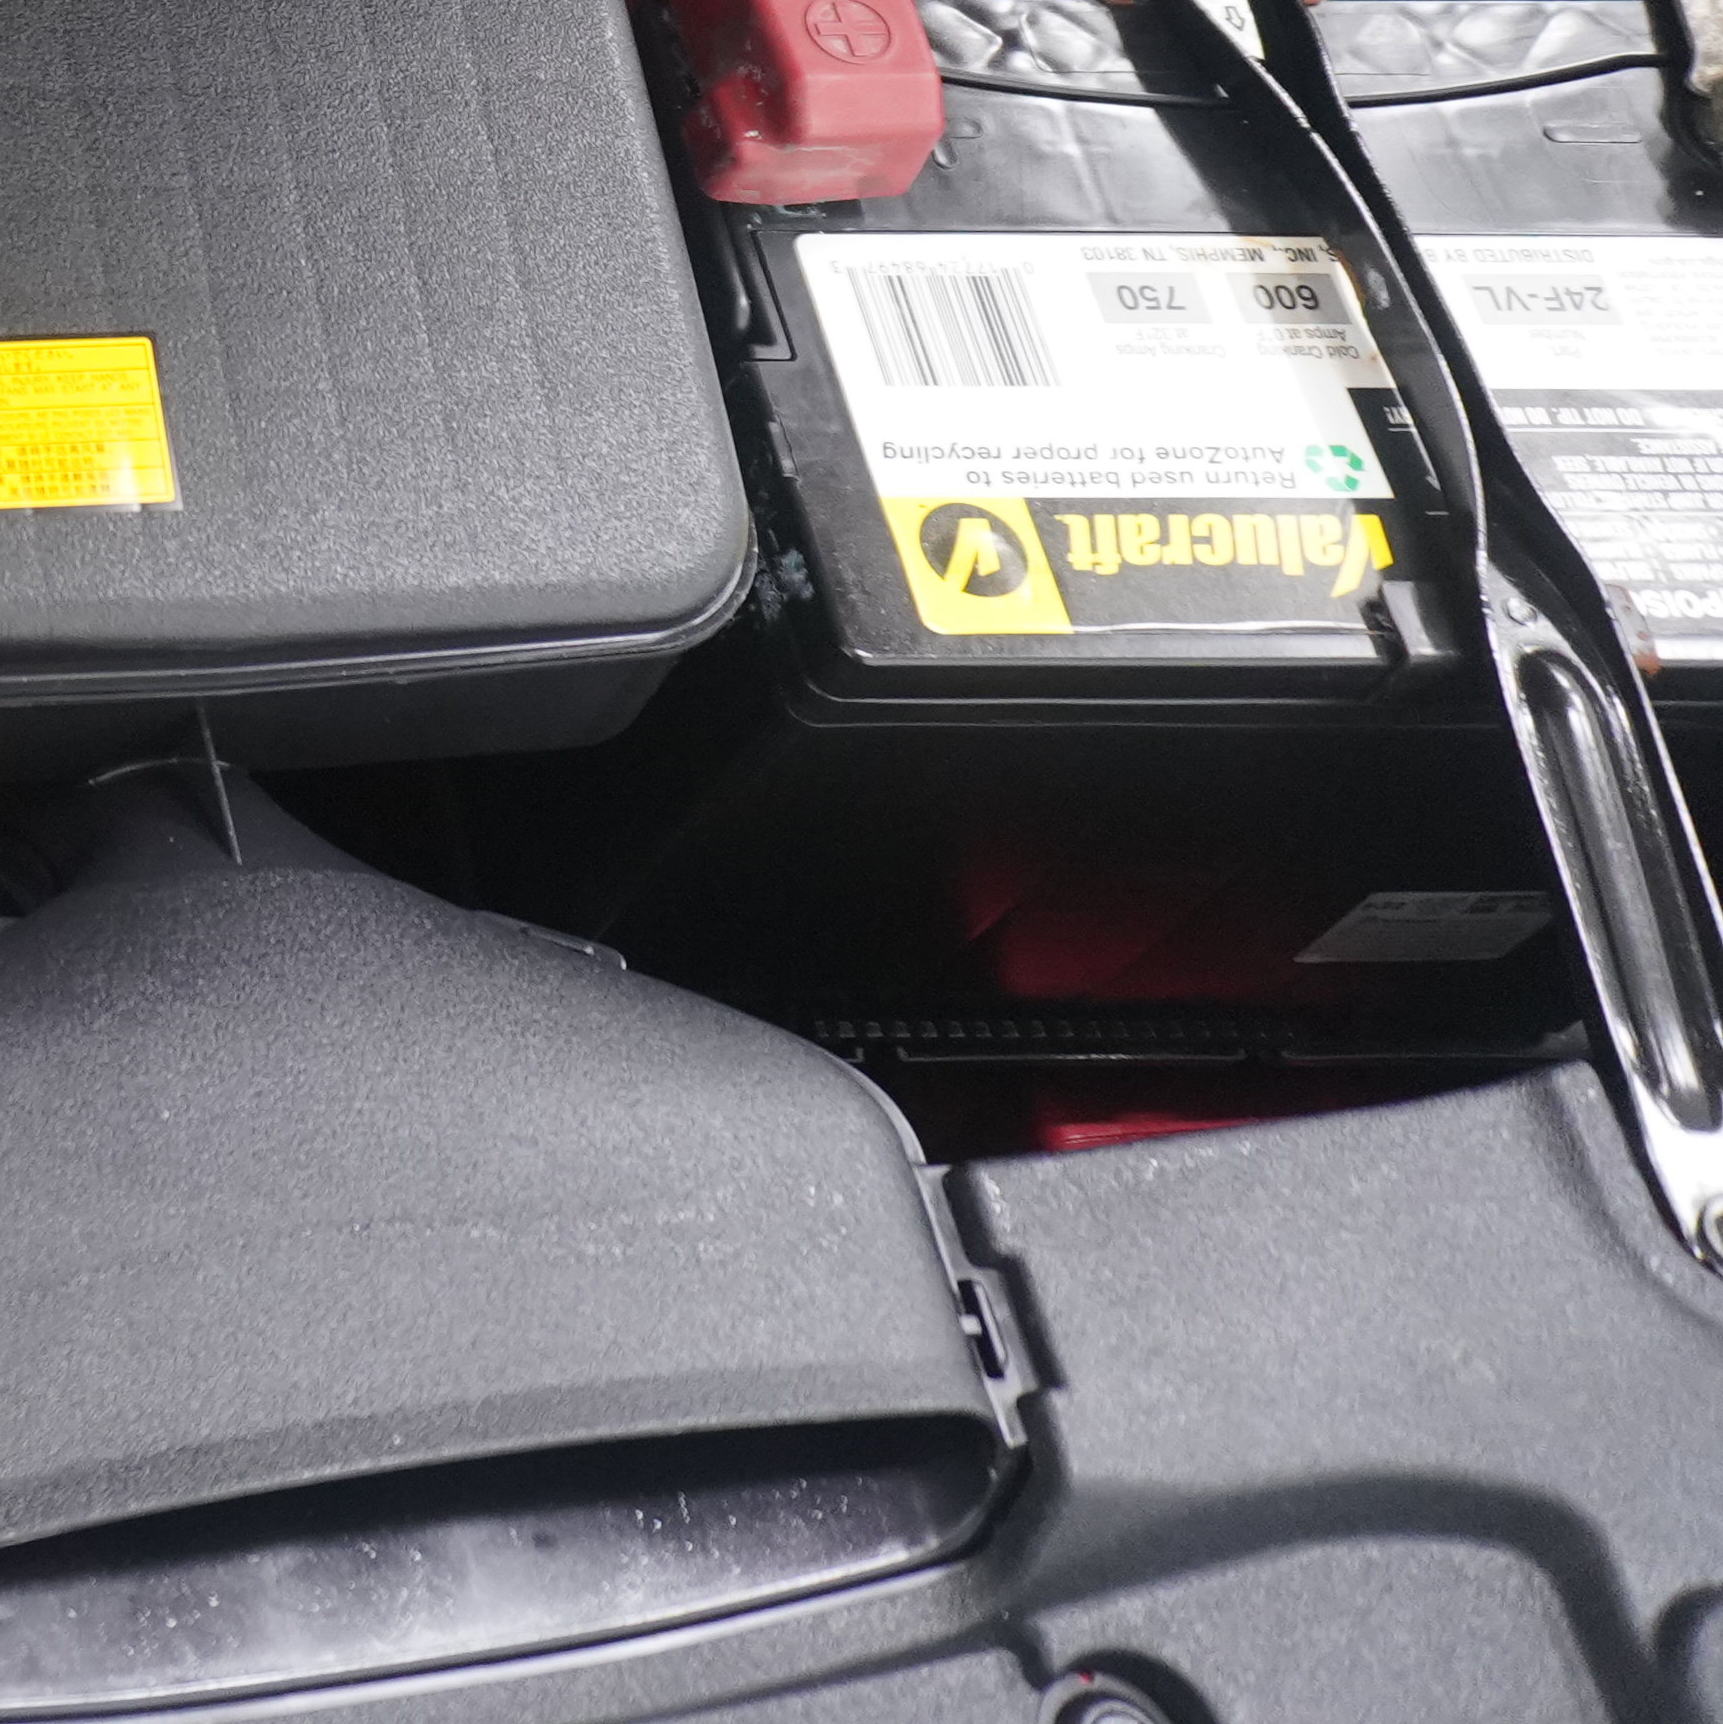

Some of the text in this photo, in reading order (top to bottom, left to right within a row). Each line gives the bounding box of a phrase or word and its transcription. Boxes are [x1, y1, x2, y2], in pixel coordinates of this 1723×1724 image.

[1080, 245, 1136, 261] 38103
[1138, 246, 1166, 261] TN
[1168, 244, 1265, 264] MEMPHIS,
[1444, 248, 1468, 262] BY
[1473, 248, 1595, 264] DISTRIBUTED
[1115, 284, 1187, 313] 750
[1252, 284, 1319, 313] 600
[1472, 285, 1611, 312] 24F-VL
[1304, 325, 1347, 342] Amps
[1114, 341, 1227, 359] Cranking Amps
[1255, 341, 1322, 361] Cranking
[881, 442, 1285, 466] AutoZone for proper recycling
[966, 469, 1296, 490] Return used batteries to
[1065, 512, 1394, 599] Valucraft
